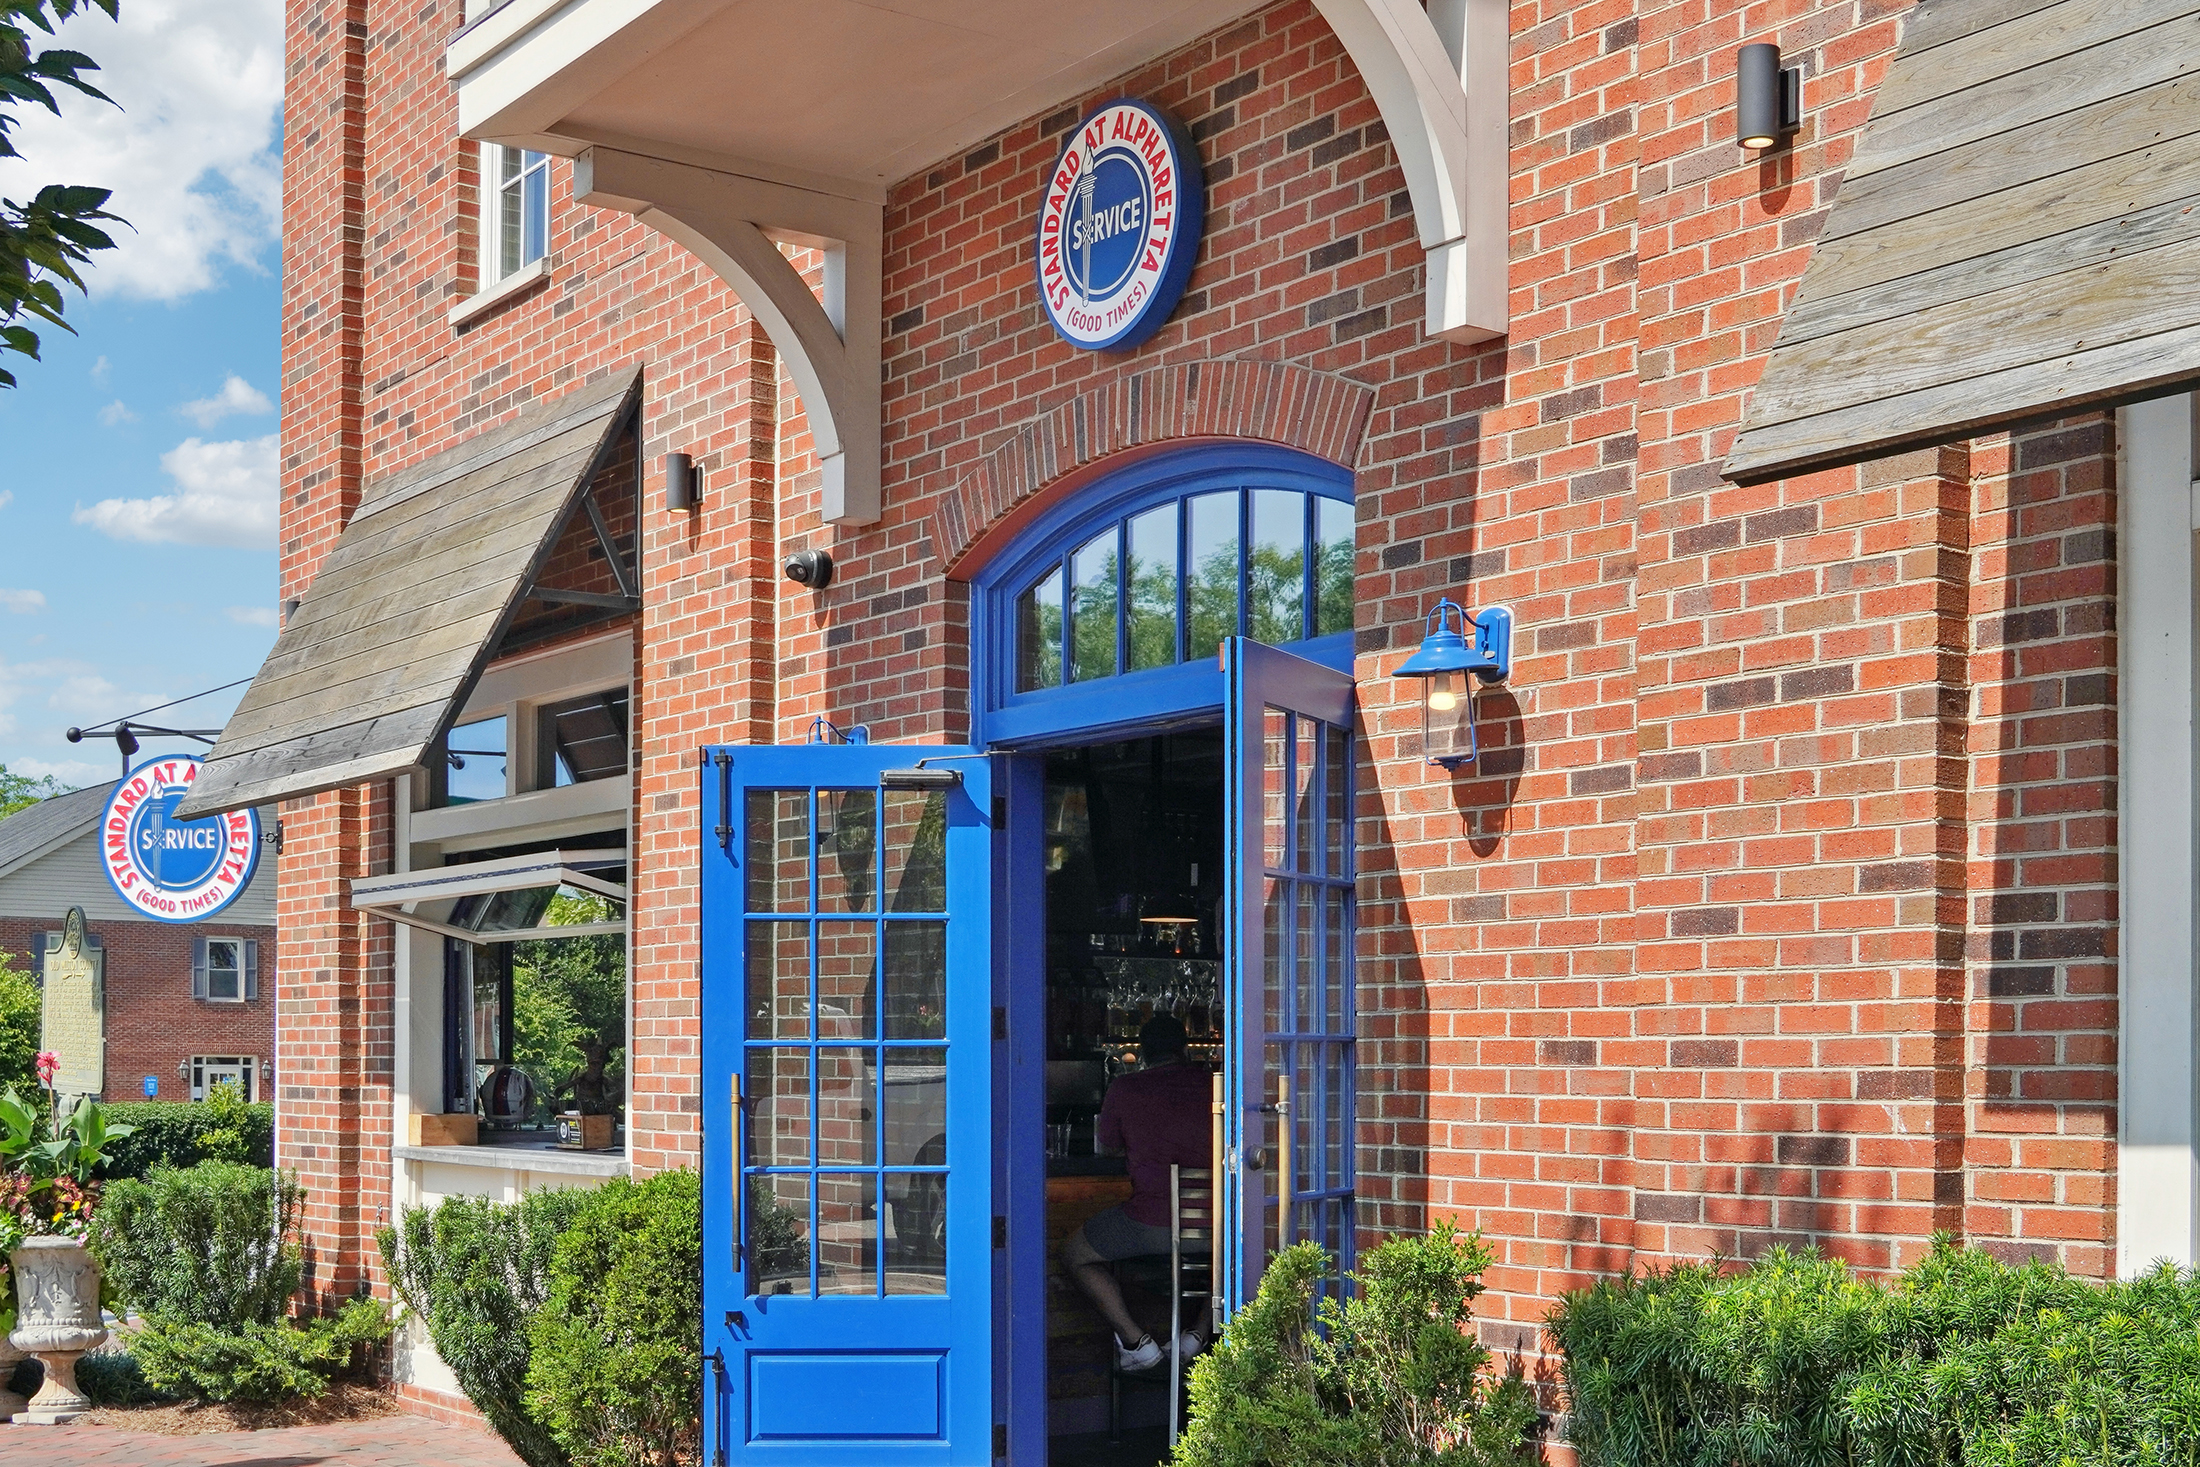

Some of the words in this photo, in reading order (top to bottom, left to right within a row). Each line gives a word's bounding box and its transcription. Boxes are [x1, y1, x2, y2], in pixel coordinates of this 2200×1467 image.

[1043, 150, 1080, 312] STANDARD
[1085, 116, 1107, 151] AT
[1111, 111, 1172, 273] ALPHARETTA
[1066, 307, 1102, 332] (GOOD
[1106, 280, 1147, 328] TIMES)
[108, 777, 148, 889] STANDARD
[154, 763, 177, 785] AT
[136, 888, 176, 913] (GOOD
[181, 885, 225, 913] TIMES)
